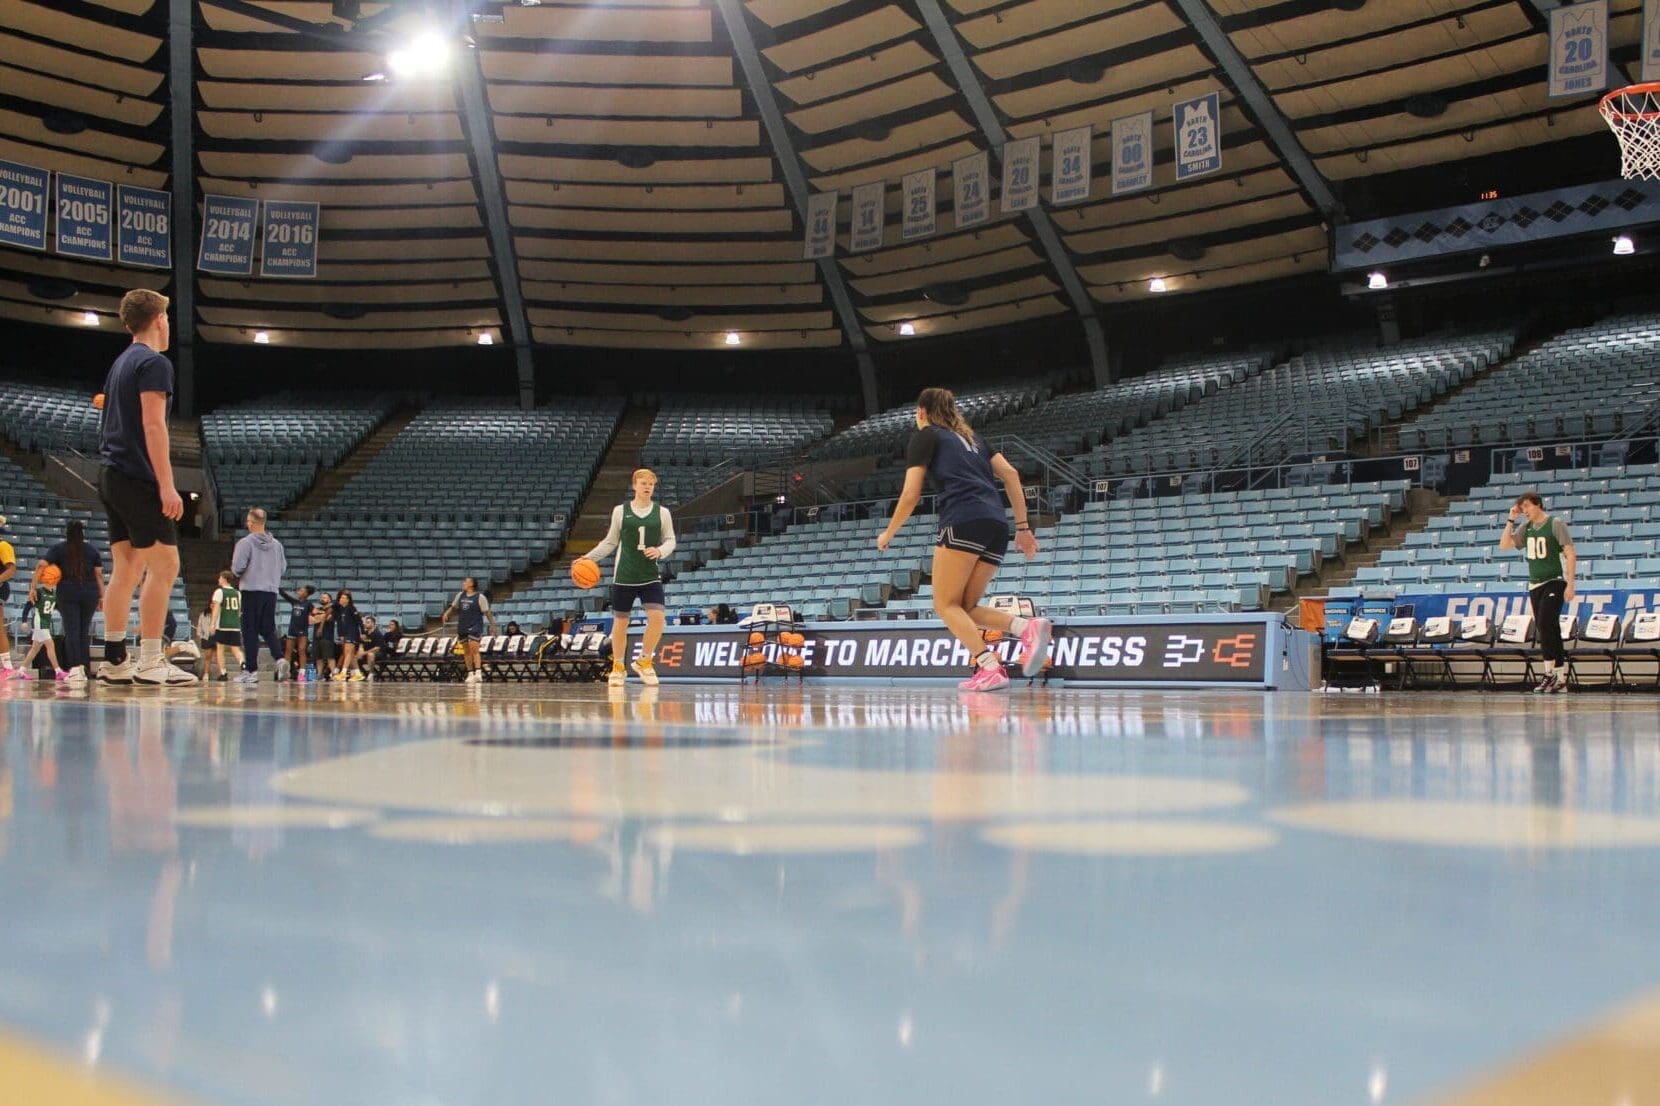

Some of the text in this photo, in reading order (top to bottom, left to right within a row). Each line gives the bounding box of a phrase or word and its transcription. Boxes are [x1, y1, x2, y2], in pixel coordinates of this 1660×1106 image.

[1565, 38, 1592, 63] 20
[1187, 127, 1208, 148] 23
[1187, 159, 1210, 173] SMITH
[0, 170, 43, 187] VOLLEYBALL
[62, 184, 105, 199] VOLLEYBALL
[0, 185, 42, 214] 2001
[124, 195, 165, 209] VOLLEYBALL
[60, 199, 107, 225] 2005
[209, 205, 252, 218] VOLLEYBALL
[270, 210, 312, 220] VOLLEYBALL
[9, 213, 27, 225] ACC
[122, 209, 168, 234] 2008
[0, 225, 40, 239] HAMPIONS
[76, 226, 92, 236] ACC
[207, 218, 251, 241] 2014
[268, 223, 313, 244] 2016
[61, 235, 106, 249] CHAMPIONS
[137, 235, 152, 245] ACC
[123, 245, 167, 258] CHAMPIONS
[218, 243, 235, 253] ACC
[282, 247, 298, 257] ACC
[204, 252, 247, 264] CHAMPIONS
[267, 257, 311, 268] CHAMPIONS
[1405, 458, 1418, 469] 107
[637, 526, 646, 551] 1
[226, 597, 239, 610] 10
[1446, 597, 1536, 625] FOU
[694, 636, 1146, 667] WELOE TO MARCH MNESS
